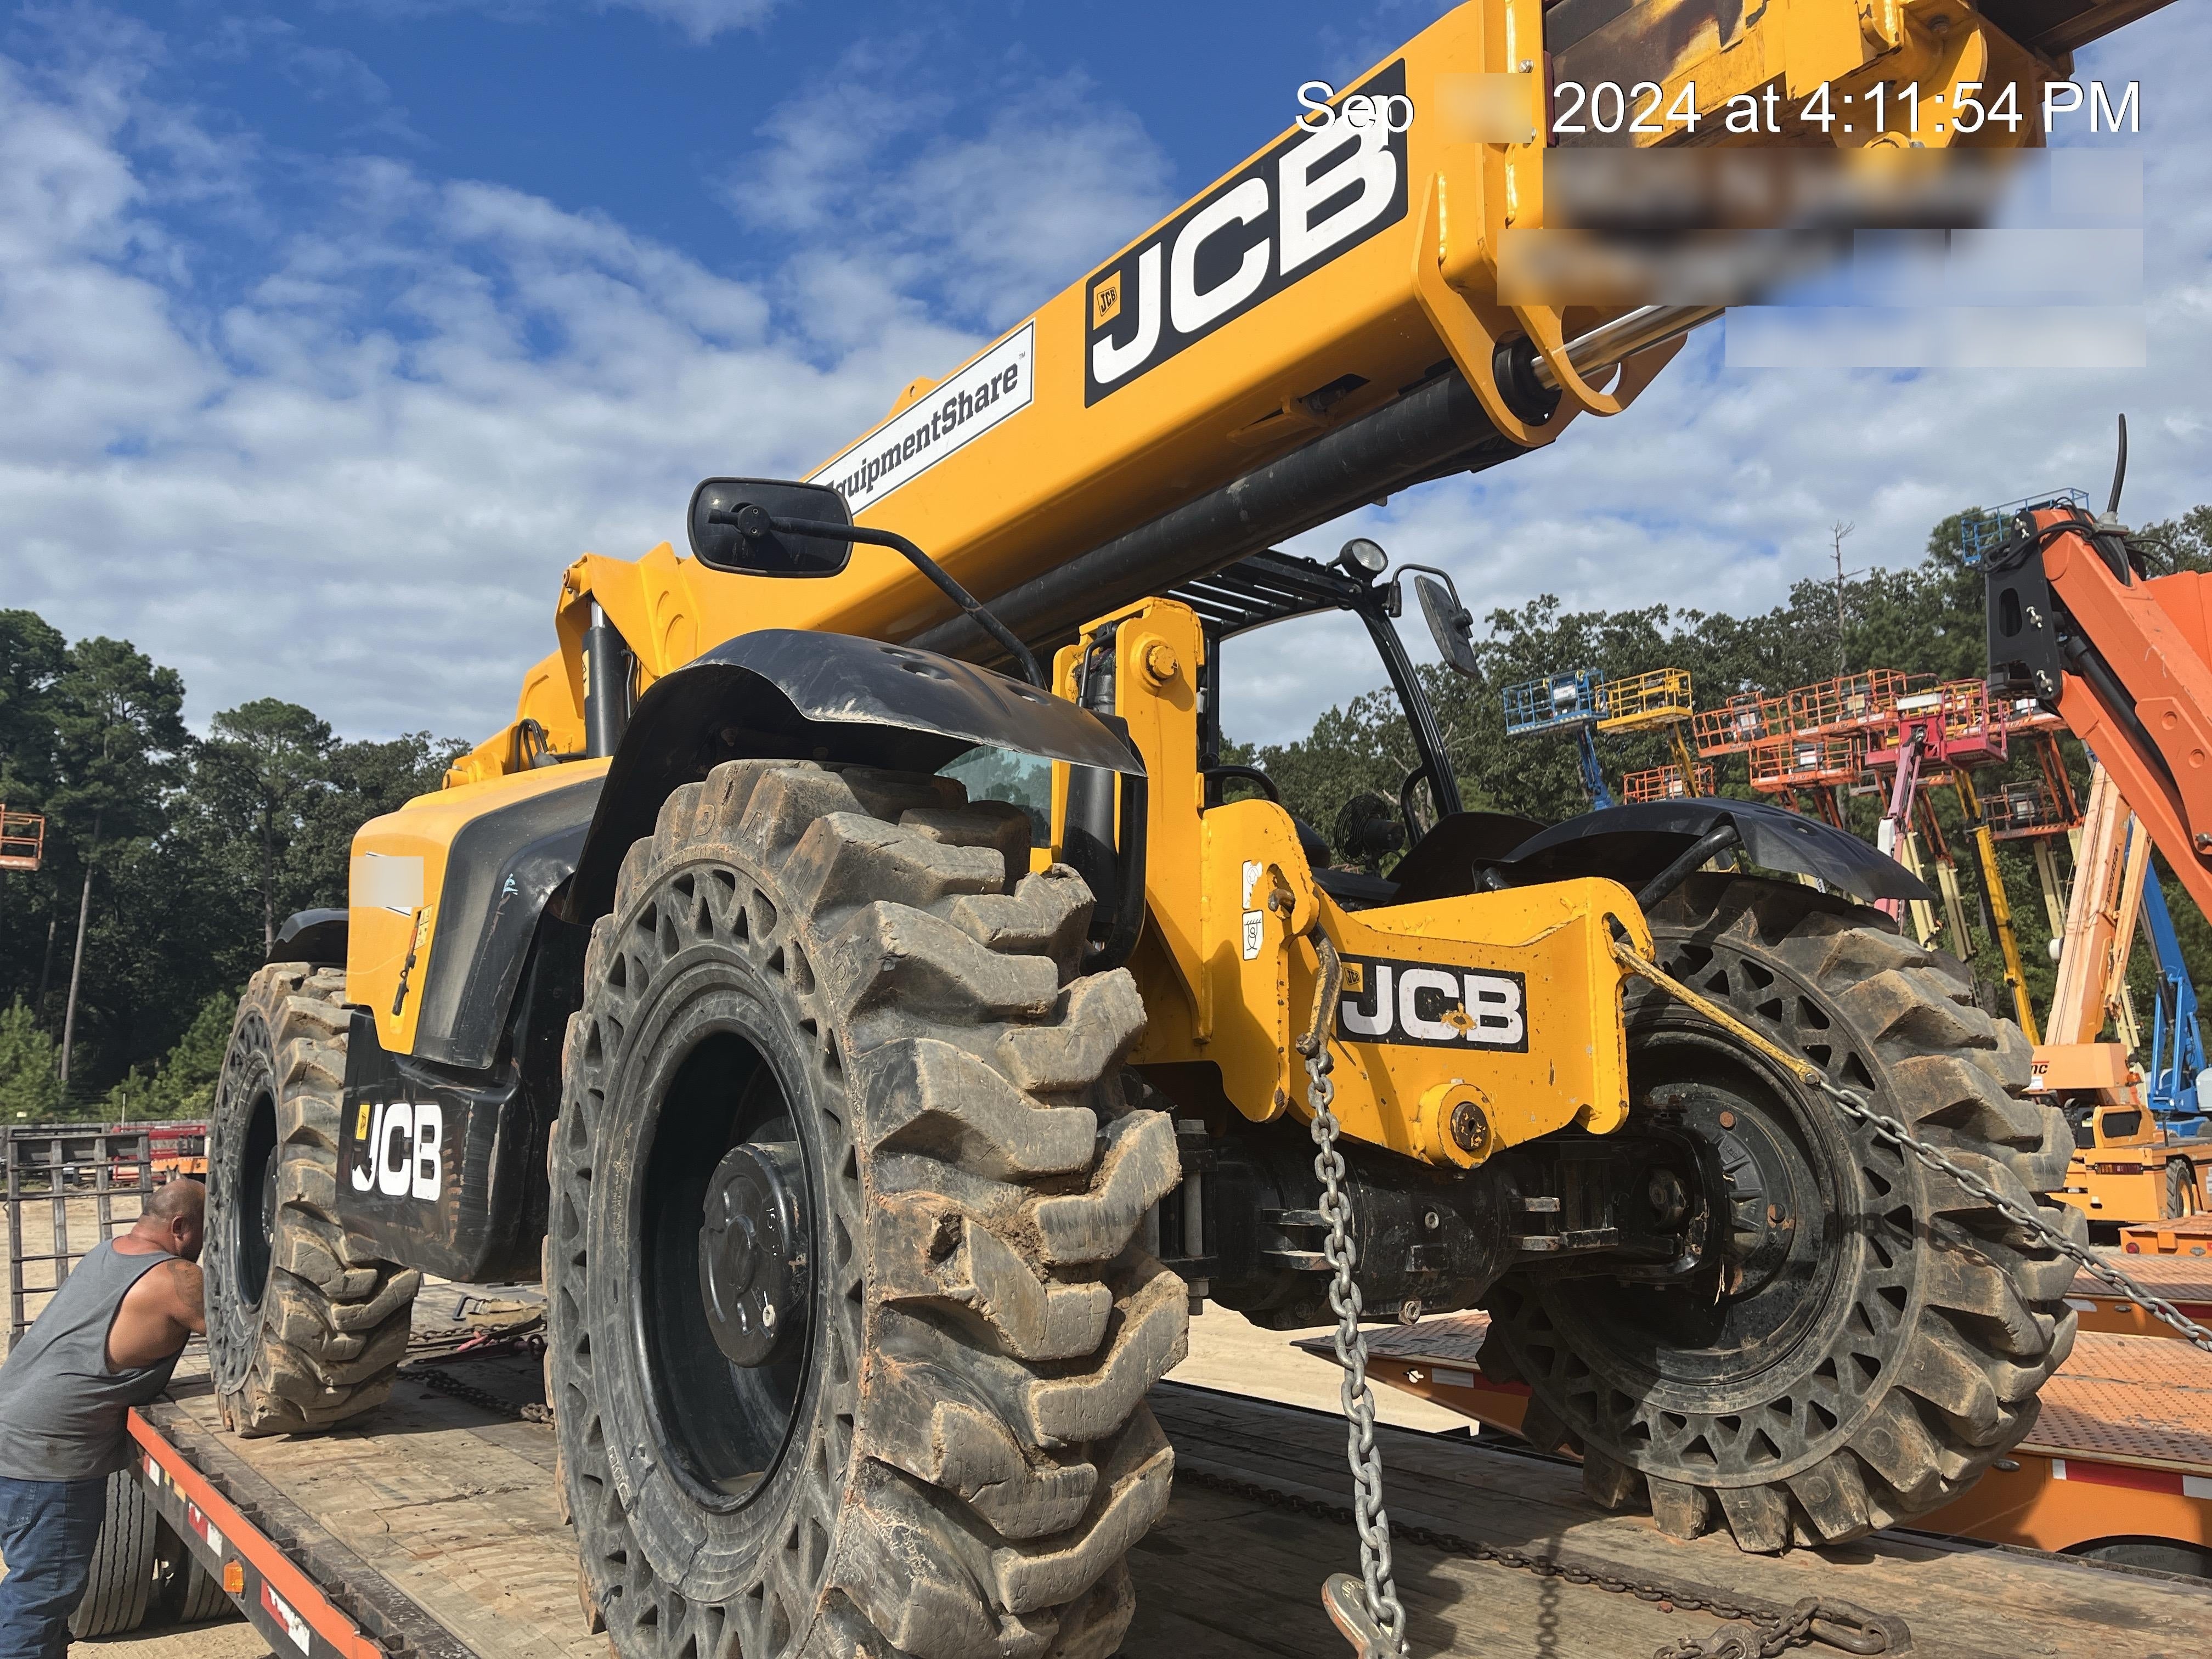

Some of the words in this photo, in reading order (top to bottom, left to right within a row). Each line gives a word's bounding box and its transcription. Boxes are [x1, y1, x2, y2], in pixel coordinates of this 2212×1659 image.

[1093, 95, 1397, 384] JCB
[1099, 288, 1116, 313] JCB
[1342, 965, 1523, 1043] JCB
[1346, 969, 1360, 985] JCB
[352, 1103, 442, 1201] JCB
